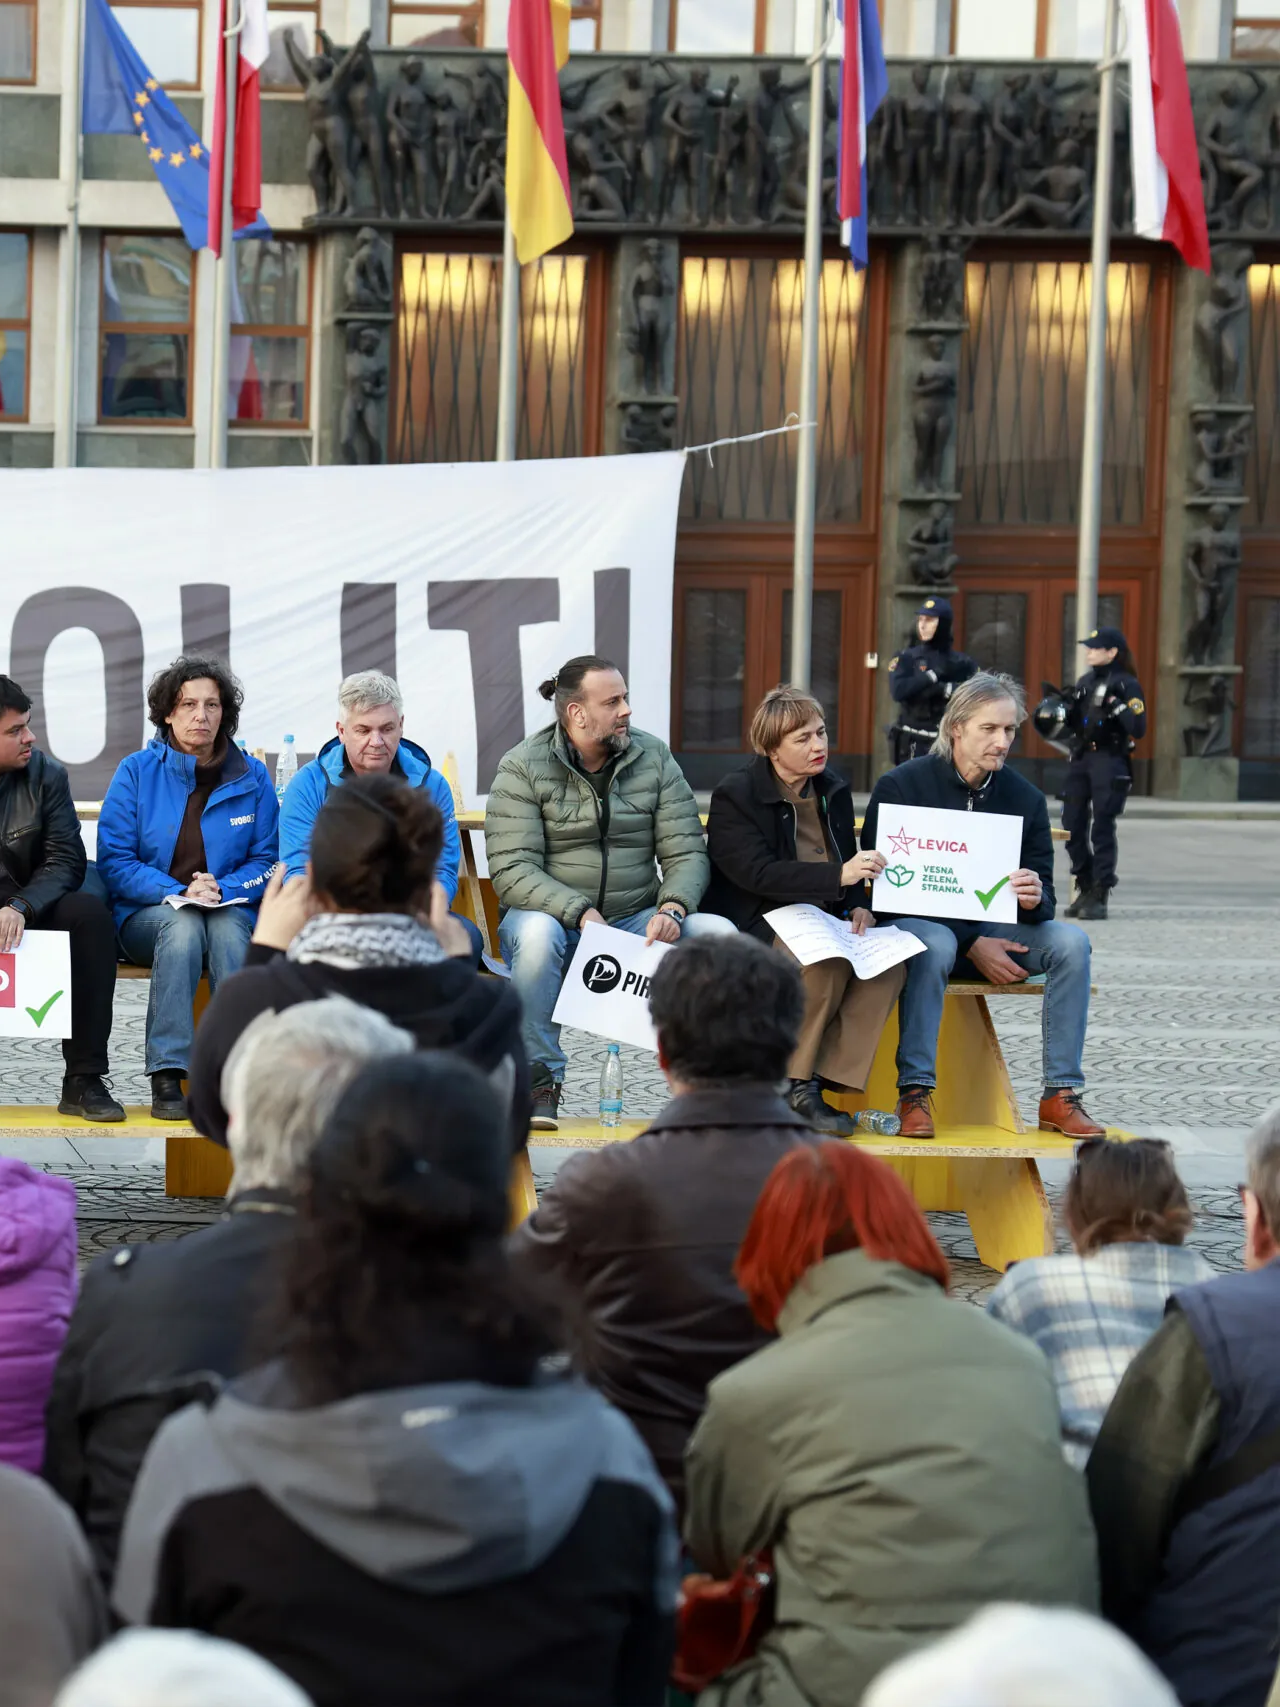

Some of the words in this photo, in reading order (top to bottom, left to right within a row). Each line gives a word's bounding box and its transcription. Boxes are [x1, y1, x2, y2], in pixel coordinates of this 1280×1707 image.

[917, 838, 969, 854] LEVICA
[923, 865, 954, 875] VESNA
[922, 874, 958, 885] ZELENA
[921, 883, 964, 894] STRANKA
